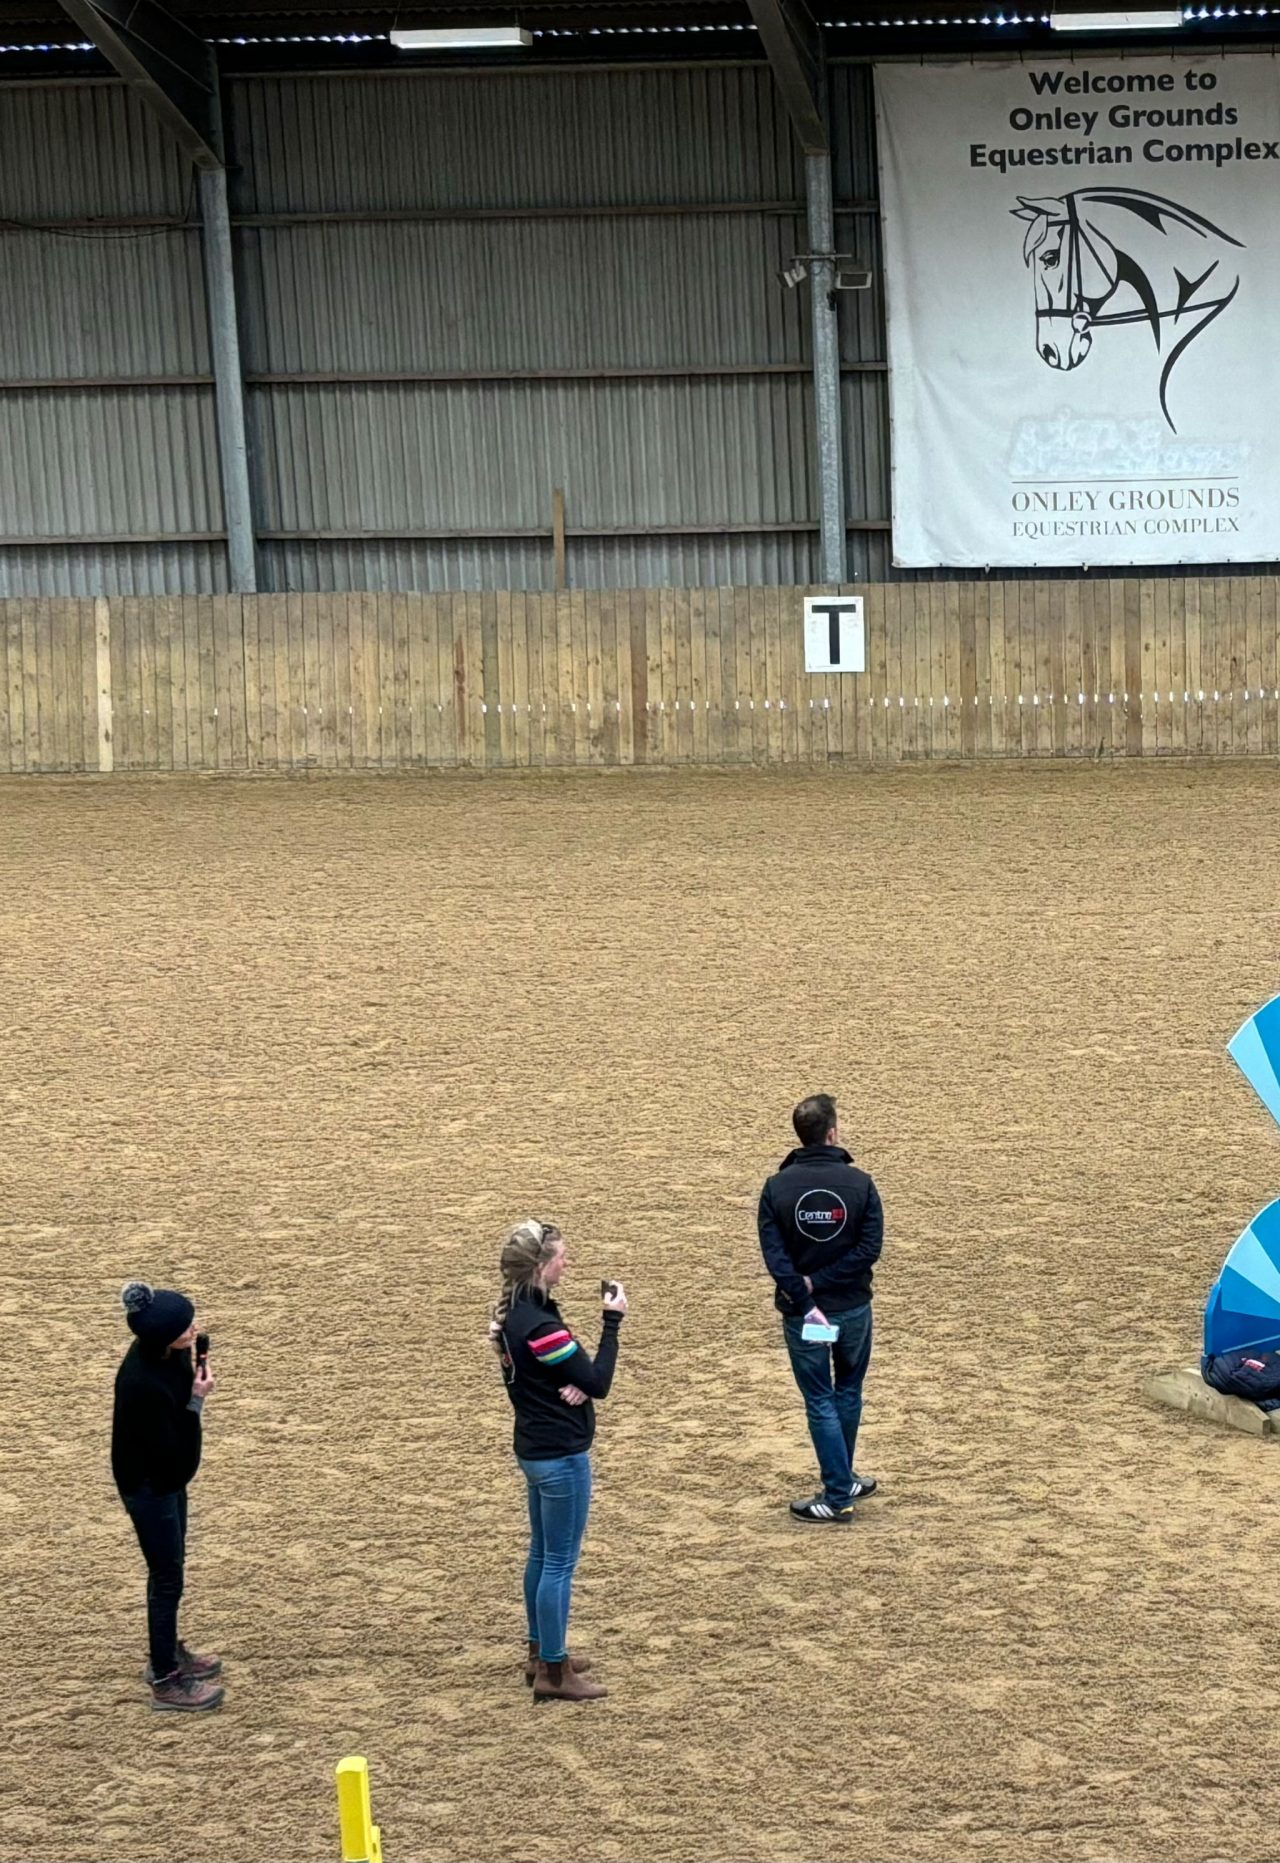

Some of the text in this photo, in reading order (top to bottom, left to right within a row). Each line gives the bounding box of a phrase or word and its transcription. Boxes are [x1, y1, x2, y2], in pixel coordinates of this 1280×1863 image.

[1029, 69, 1217, 95] Welcome to
[1009, 102, 1238, 136] Onley Grounds
[969, 137, 1280, 173] Equestrian Complex
[1012, 487, 1240, 512] ONLEY GROUNDS
[1012, 517, 1240, 539] EQUESTRIAN COMPLEX
[811, 603, 857, 665] T
